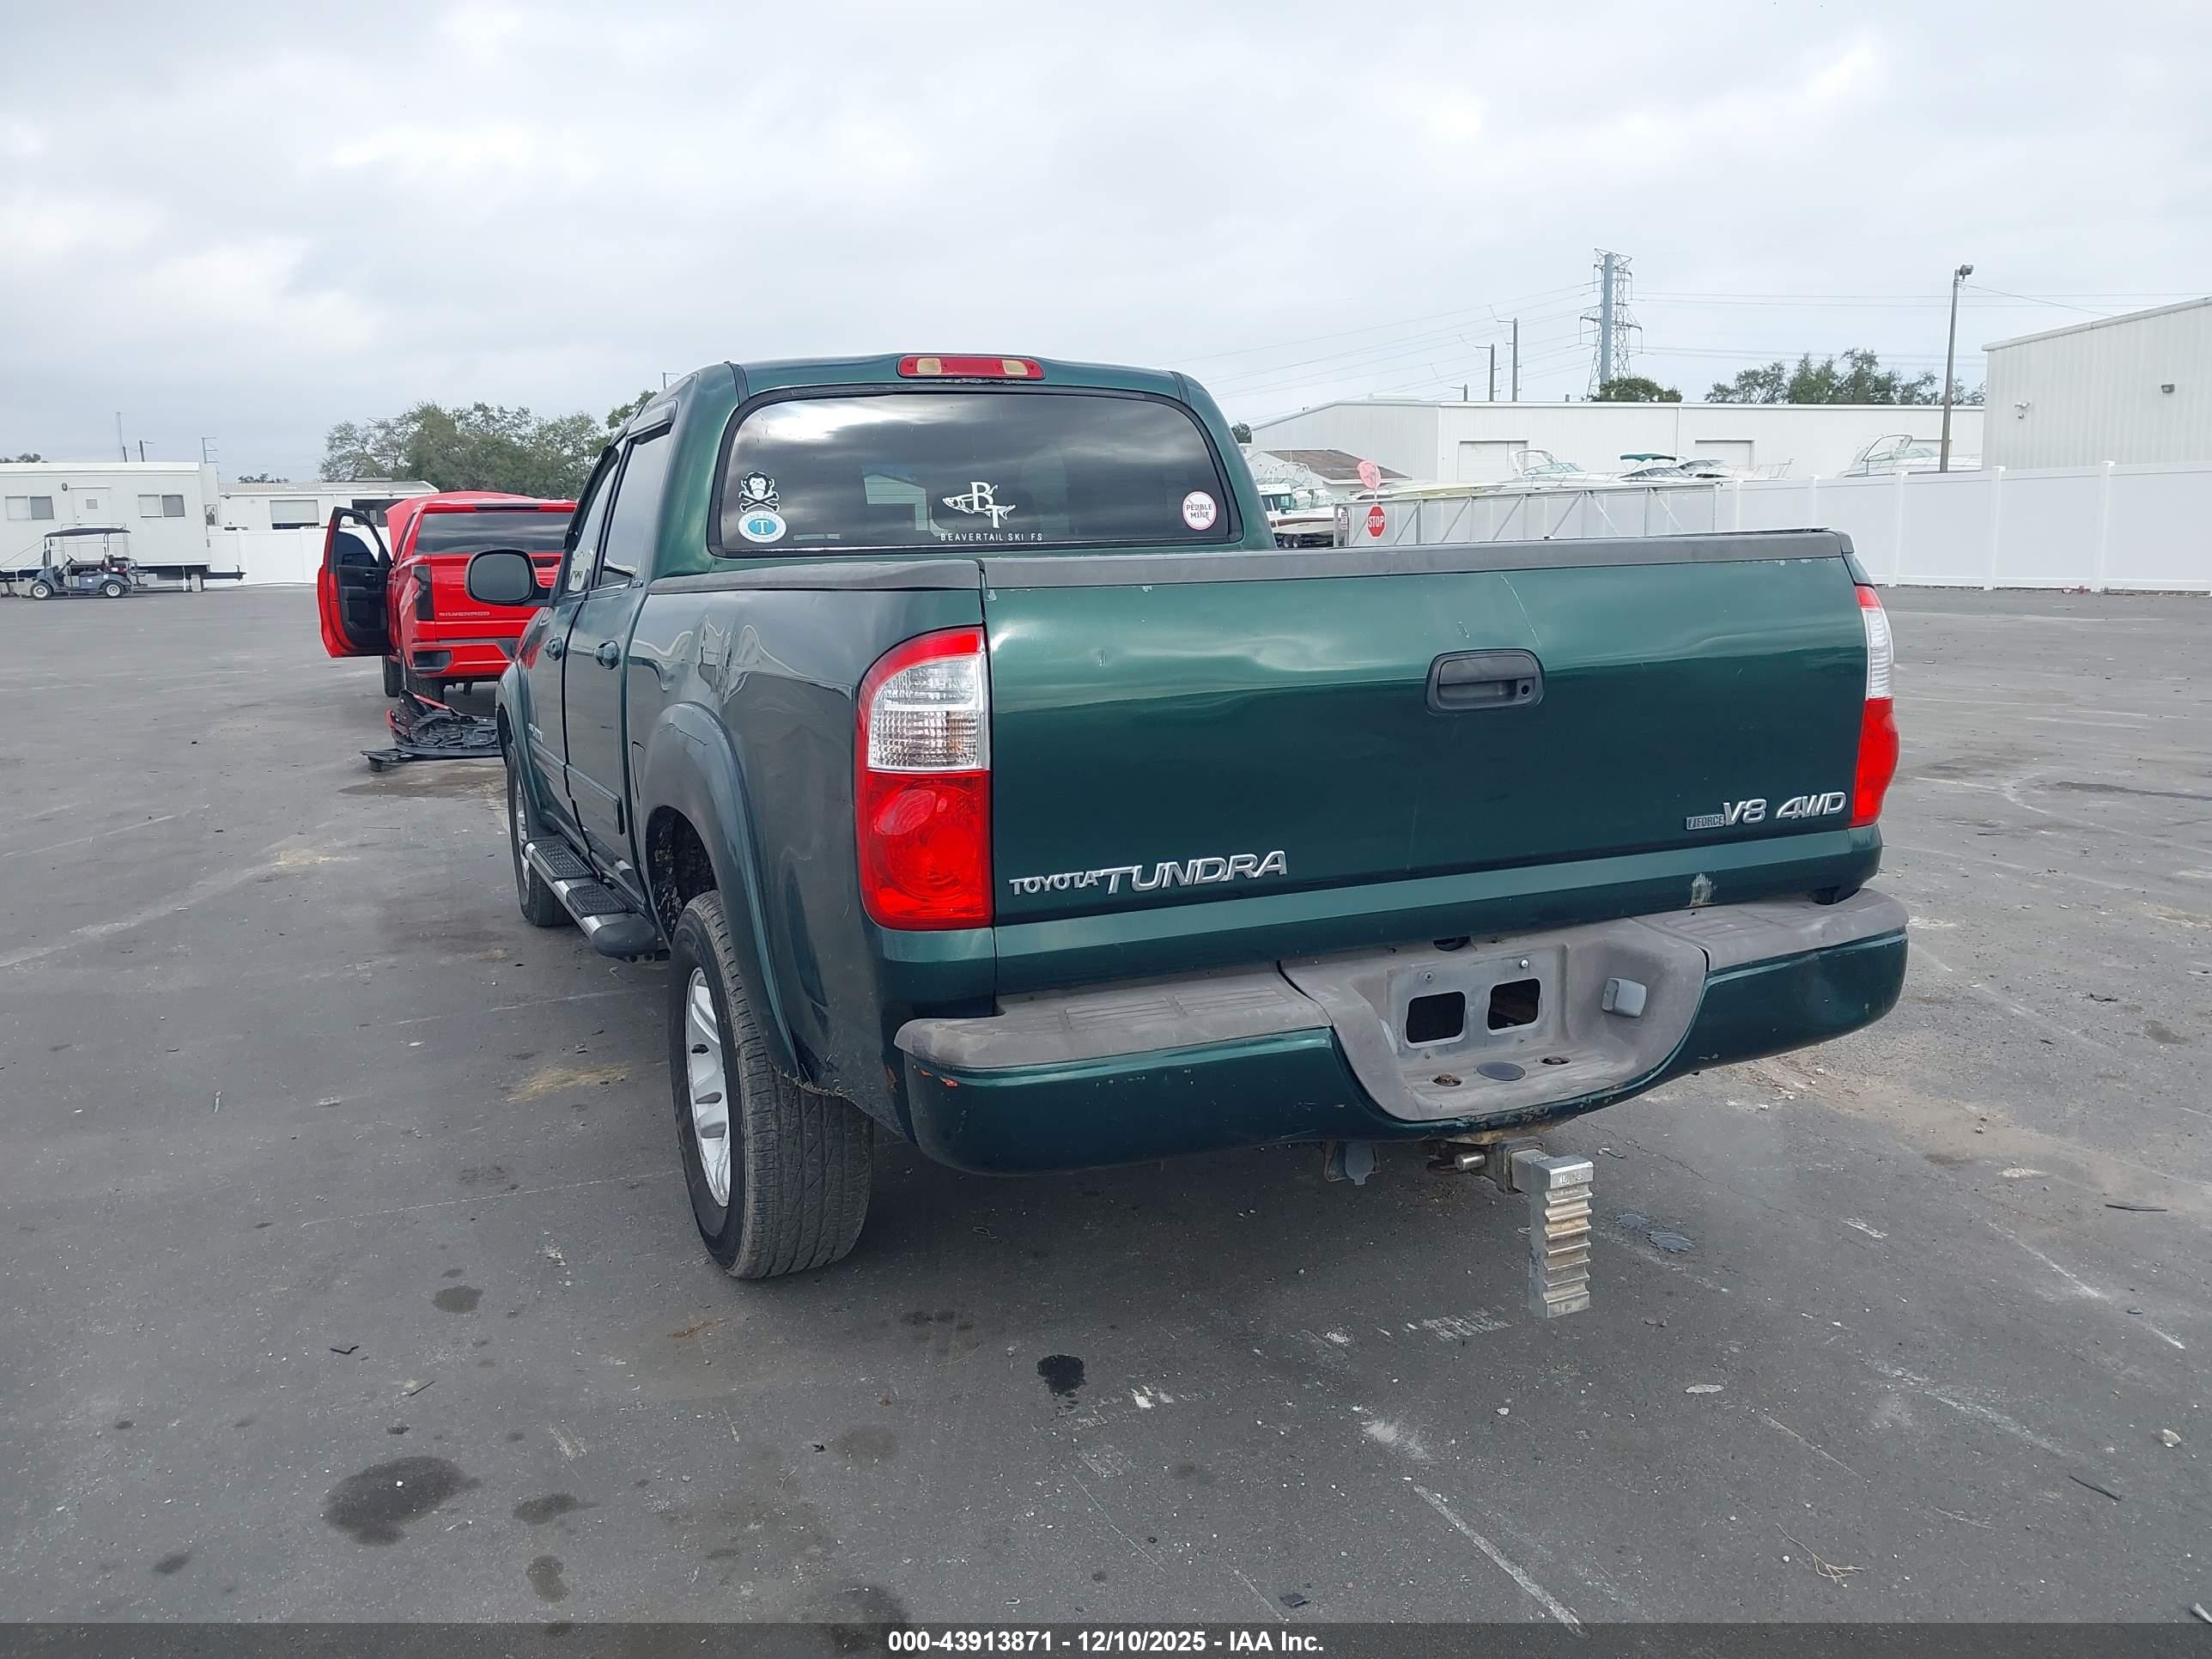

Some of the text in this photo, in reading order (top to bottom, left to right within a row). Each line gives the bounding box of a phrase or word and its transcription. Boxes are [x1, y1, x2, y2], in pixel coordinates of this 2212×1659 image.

[1368, 515, 1385, 528] STOP
[940, 532, 1004, 542] BEAVERTAIL
[1723, 799, 1766, 825] V8
[1776, 792, 1846, 819] 4WD
[1009, 850, 1287, 896] TOYOTA TUNDRA
